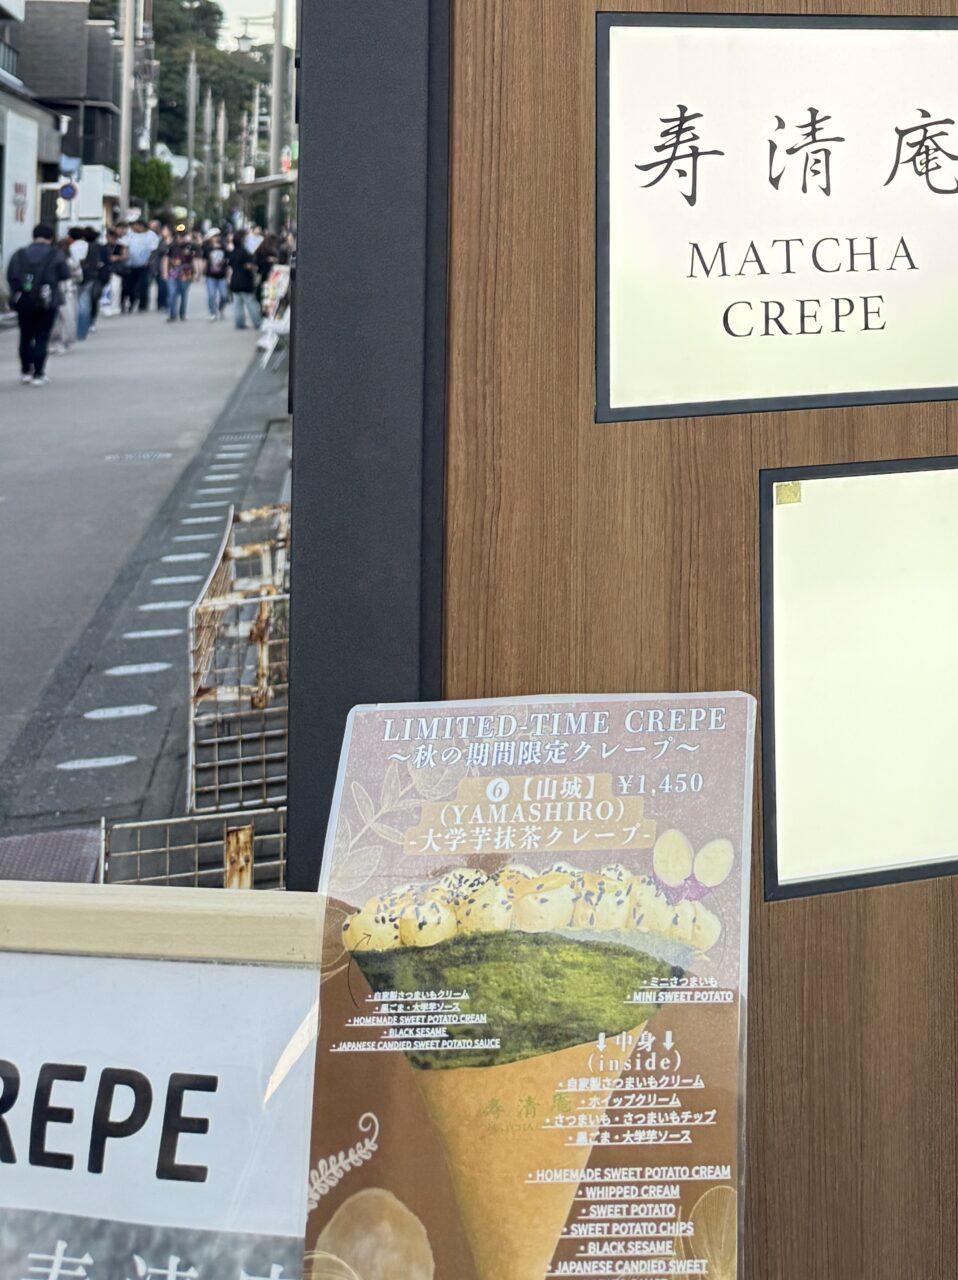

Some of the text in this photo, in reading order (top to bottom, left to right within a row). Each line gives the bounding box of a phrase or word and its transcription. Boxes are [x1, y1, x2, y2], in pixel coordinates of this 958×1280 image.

[686, 236, 920, 278] MATCHA
[722, 294, 887, 338] CREPE
[382, 707, 727, 742] LIMITED-TIME CREPE
[440, 797, 625, 827] (YAMASHIRO)
[633, 990, 733, 1002] MINI SWEET POTATO
[354, 1013, 487, 1025] HOMEMADE SWEET POTATO CREAM
[389, 1027, 447, 1037] BLACK SESAME
[338, 1038, 500, 1051] JAPANESE CANDIED SWEET POTATO SAUCE
[587, 1050, 681, 1072] (inside)
[536, 1165, 731, 1181] HOMEMADE SWEET POTATO CREAM
[585, 1184, 680, 1198] WHIPPED CREAM
[589, 1203, 675, 1217] SWEET POTATO
[570, 1221, 694, 1236] SWEET POTATO CHIPS
[588, 1240, 673, 1254] BLACK SESAME
[555, 1259, 708, 1274] JAPANESE CANDIED SWEET
